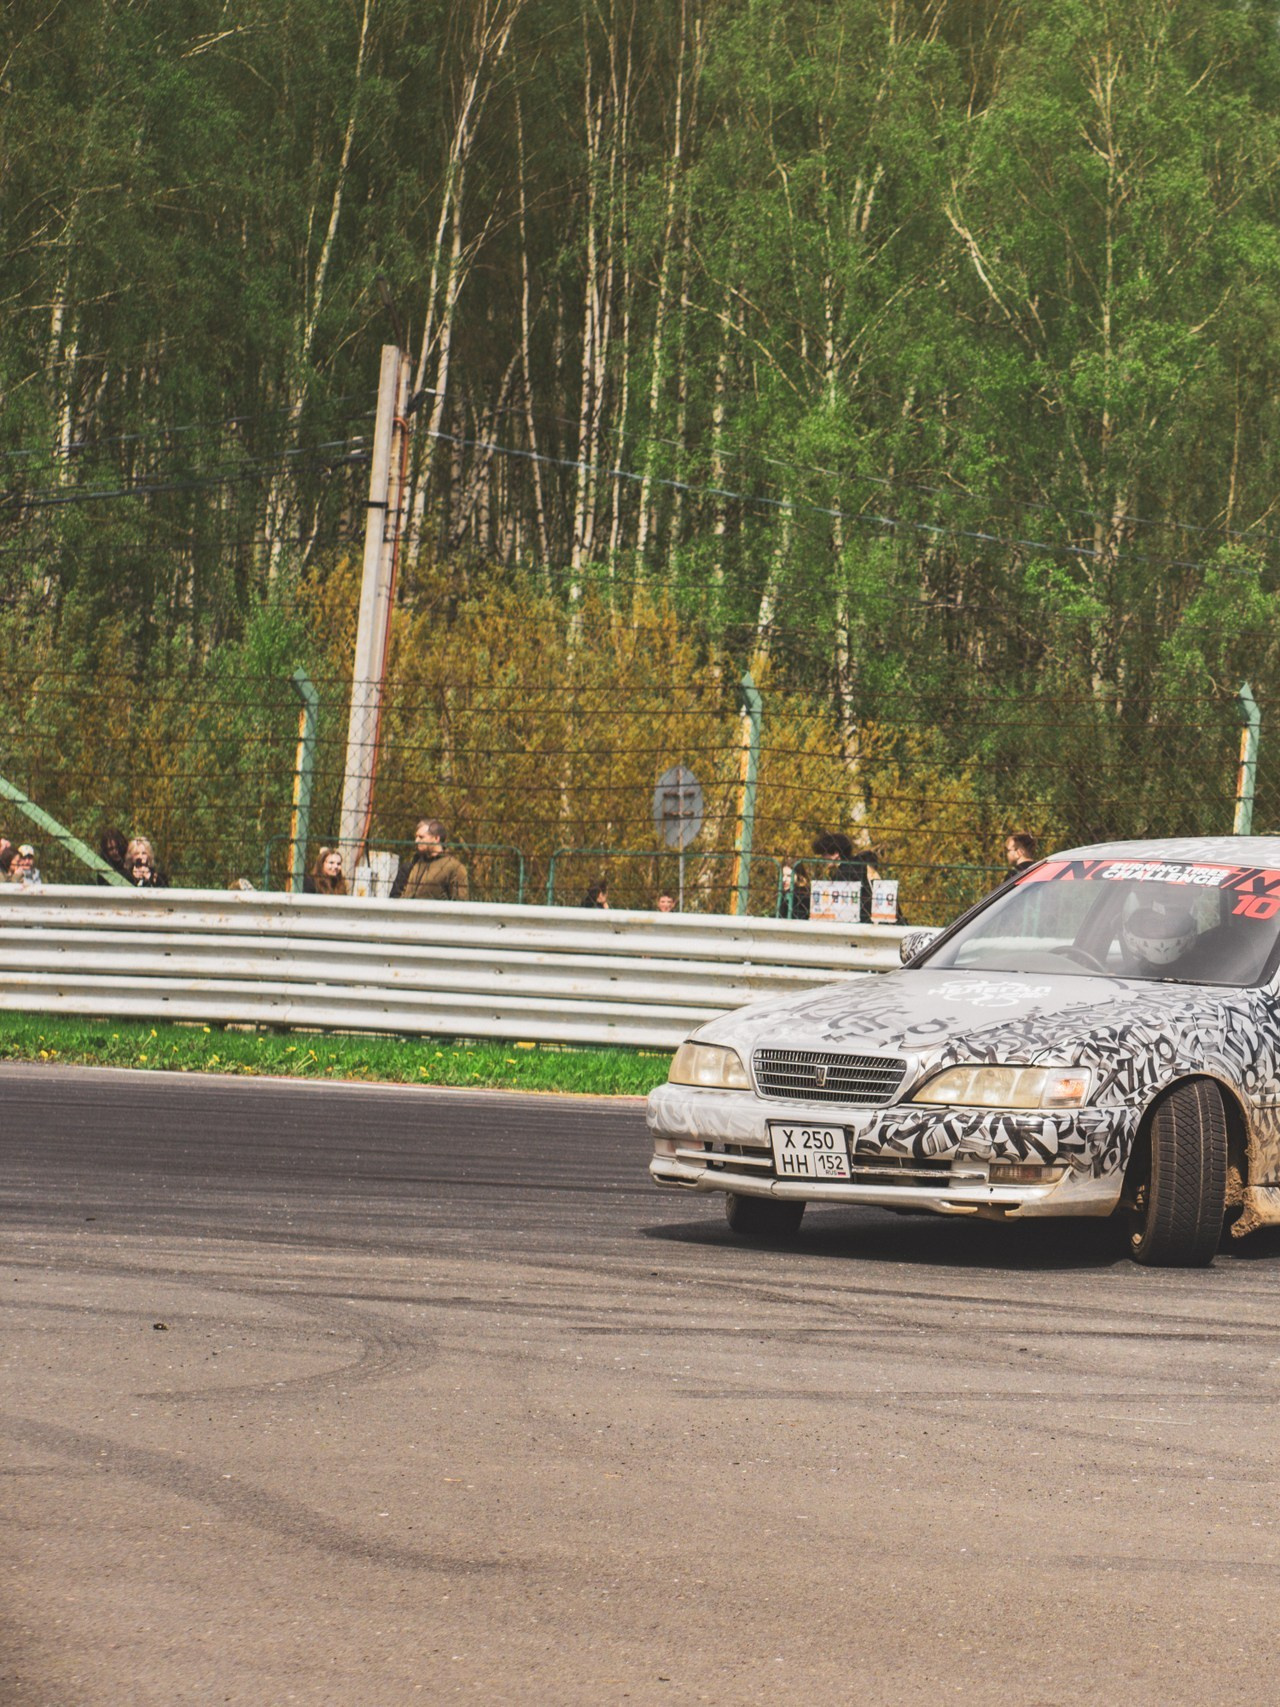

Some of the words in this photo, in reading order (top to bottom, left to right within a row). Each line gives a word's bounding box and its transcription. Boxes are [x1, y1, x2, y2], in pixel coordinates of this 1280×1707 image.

[1102, 869, 1222, 886] CHALLENGE
[1109, 862, 1182, 875] BURNING
[1184, 866, 1230, 878] TIRES
[782, 1129, 796, 1149] X
[801, 1130, 834, 1150] 250
[781, 1153, 809, 1174] HH
[818, 1154, 844, 1170] 152
